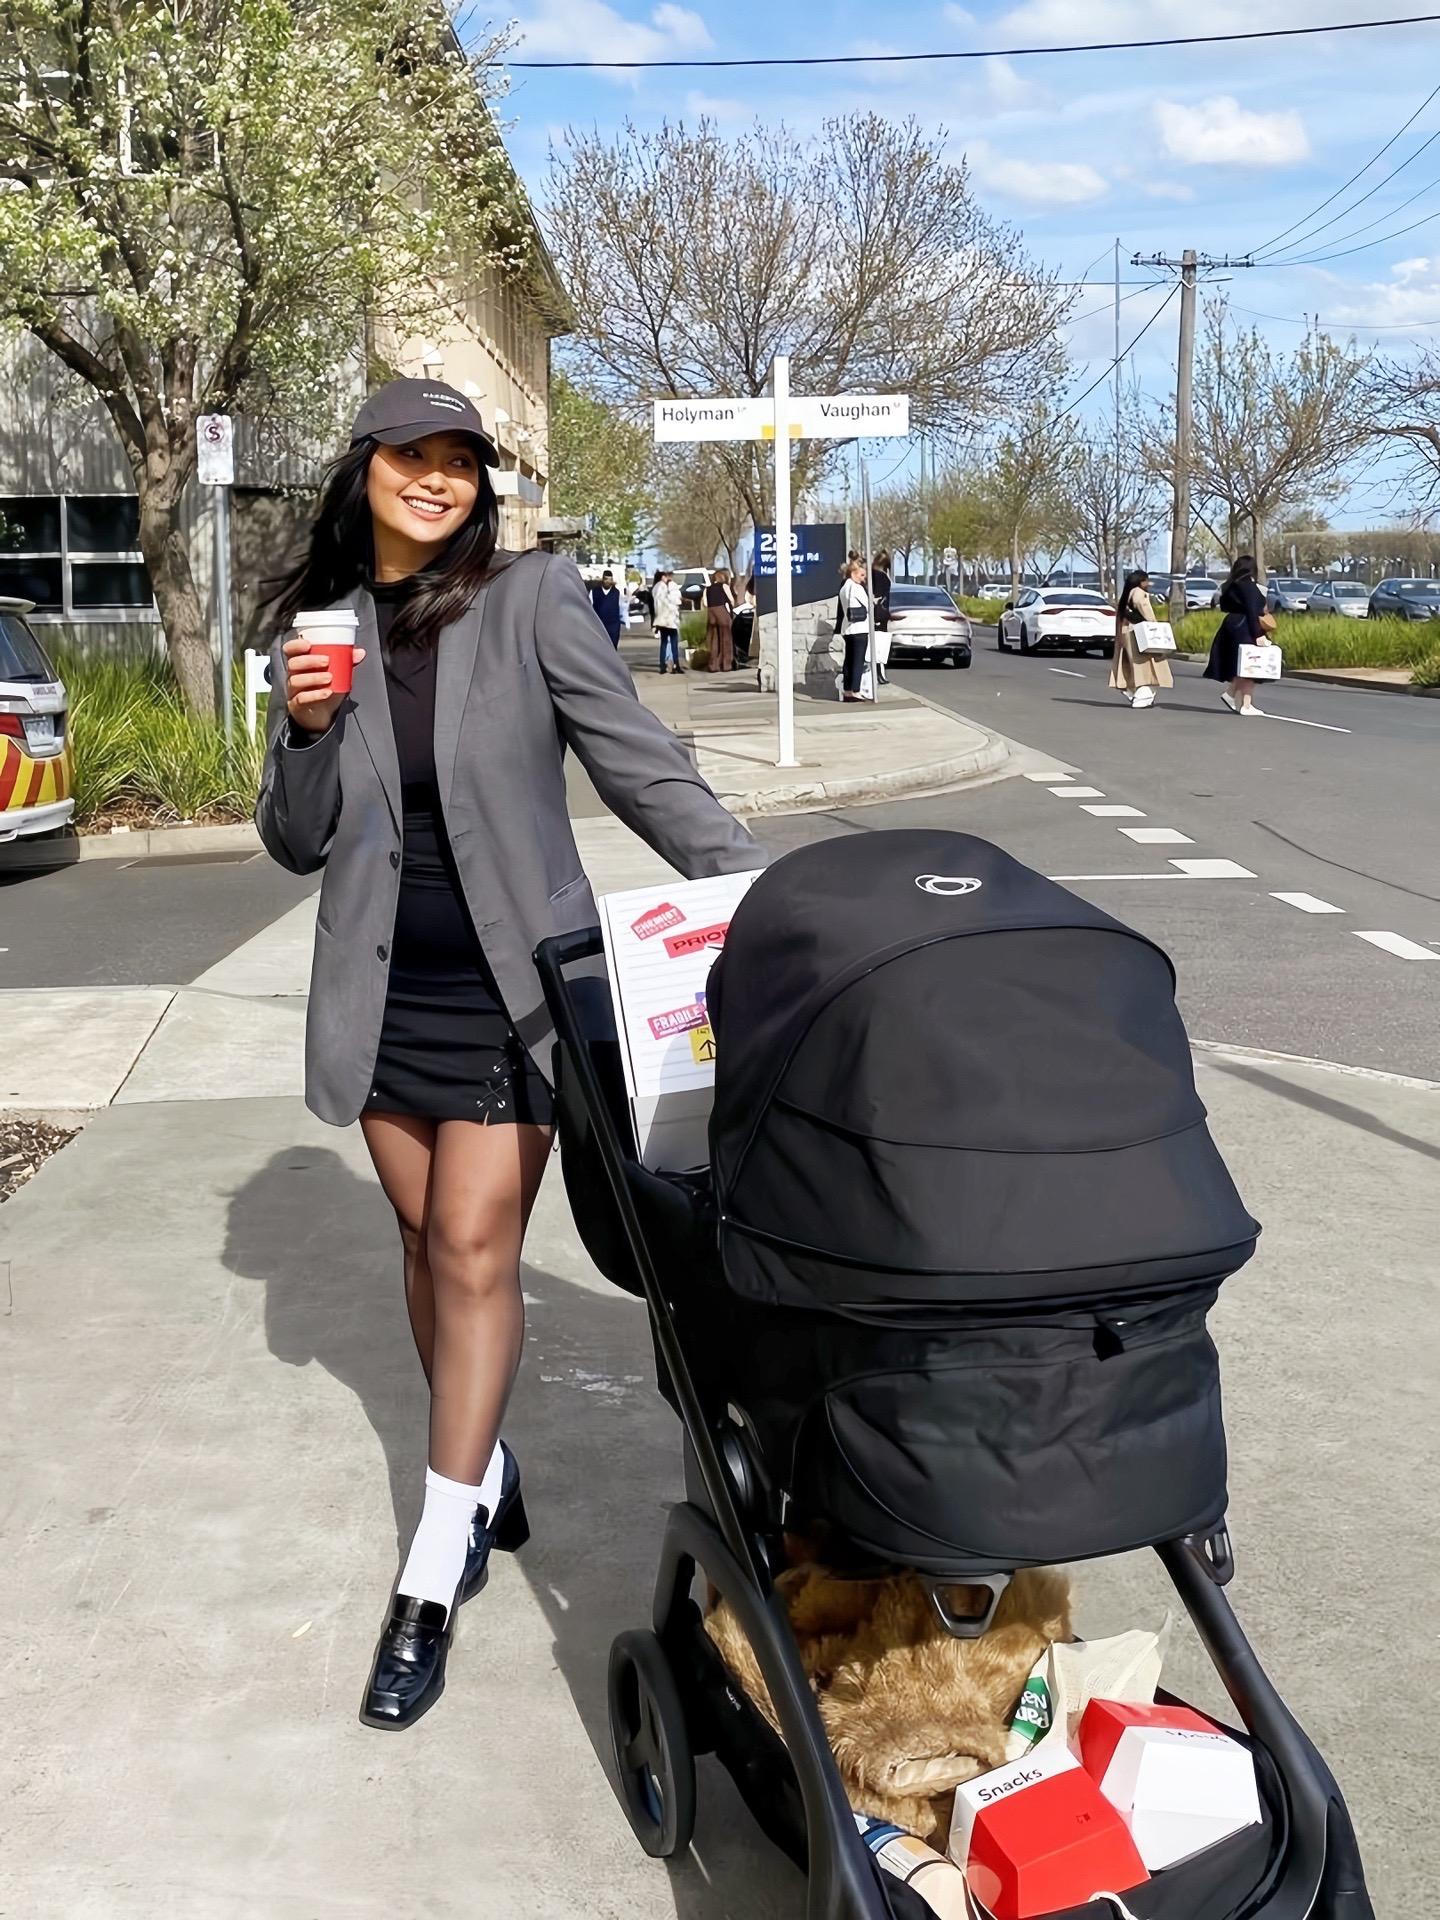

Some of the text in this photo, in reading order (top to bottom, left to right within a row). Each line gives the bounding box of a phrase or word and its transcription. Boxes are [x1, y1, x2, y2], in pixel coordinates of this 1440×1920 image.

[662, 406, 734, 424] Holyman
[820, 402, 891, 420] Vaughan
[978, 1769, 1043, 1802] Snacks
